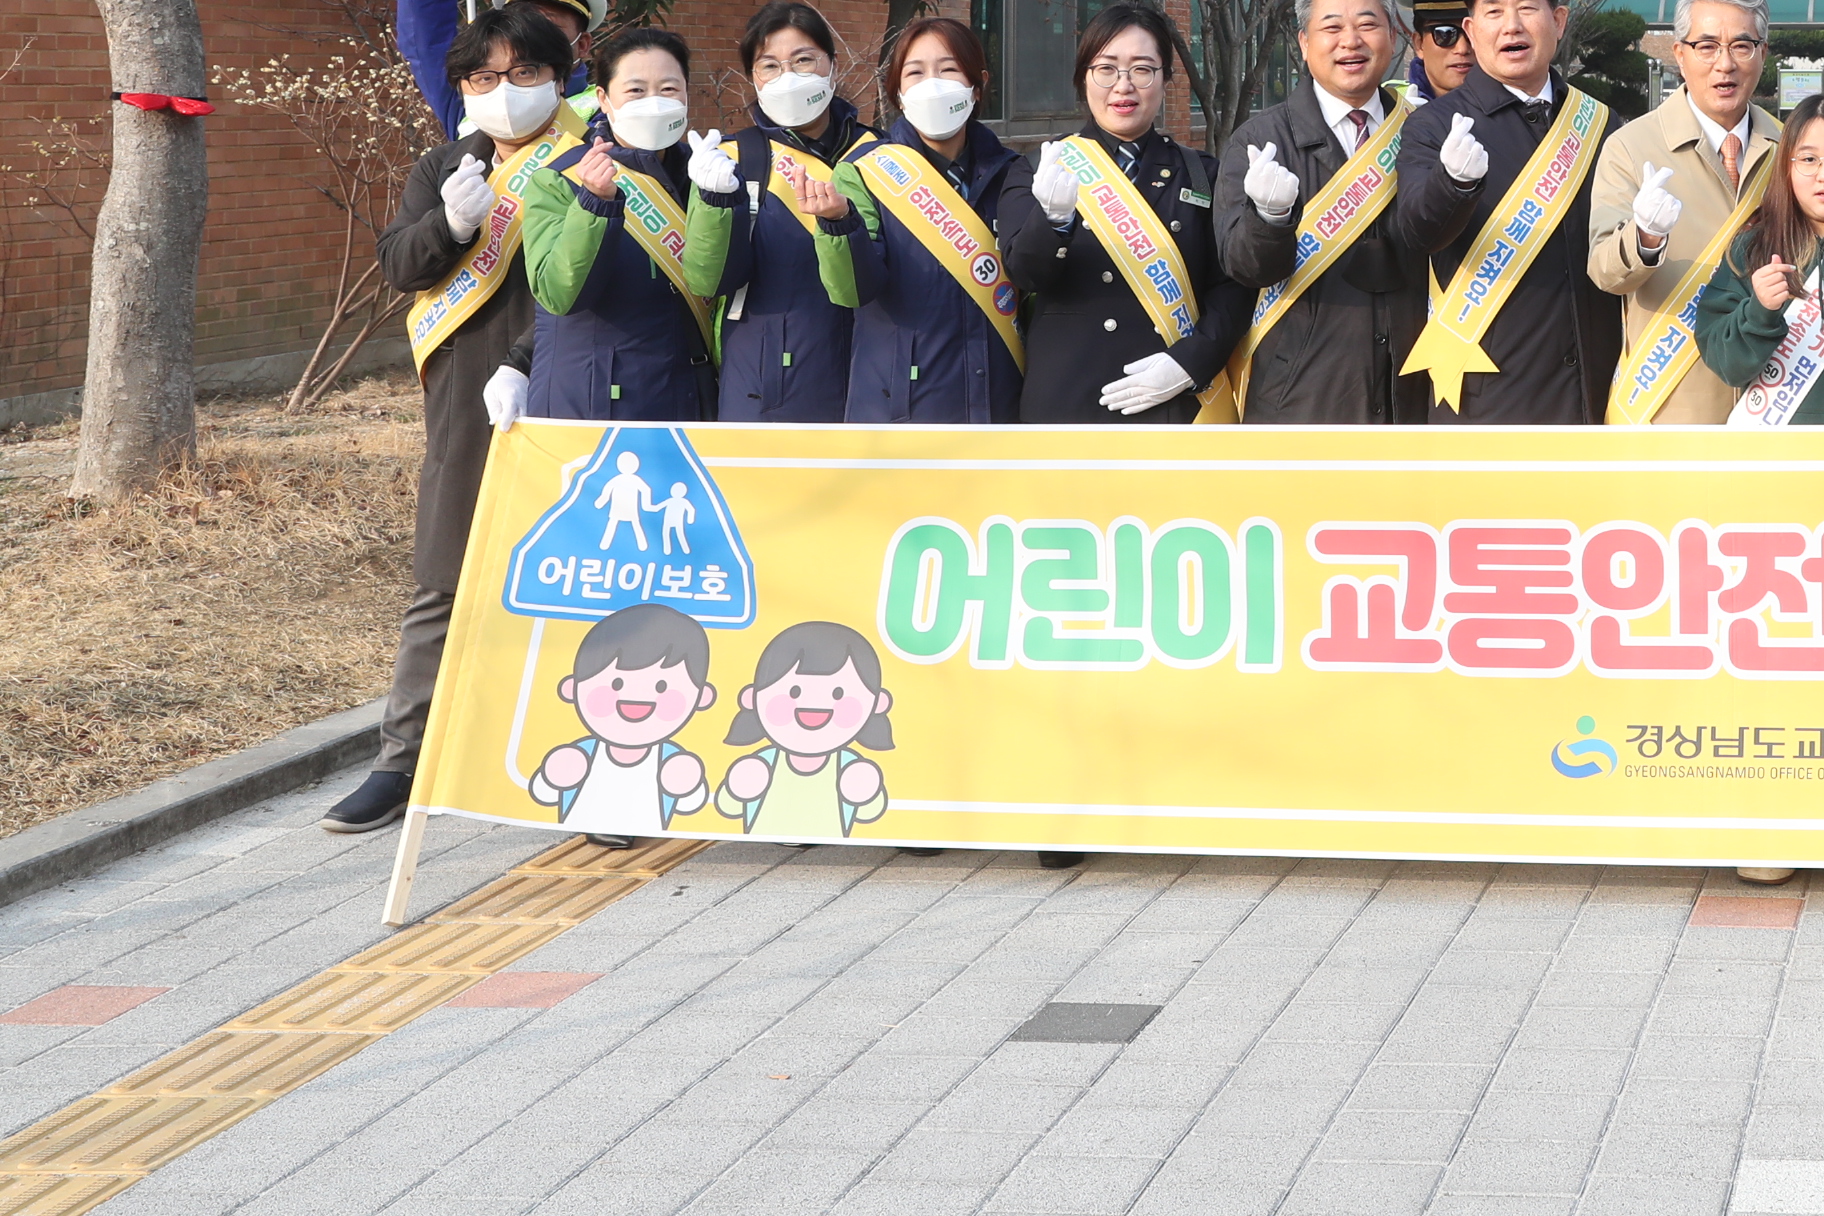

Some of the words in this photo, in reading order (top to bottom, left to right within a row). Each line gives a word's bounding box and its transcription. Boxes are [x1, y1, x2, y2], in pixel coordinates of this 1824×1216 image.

[1314, 164, 1384, 240] 교통안전
[1534, 130, 1582, 203] 교통안전
[908, 185, 980, 260] 안전속도
[974, 259, 996, 282] 30
[1090, 183, 1158, 263] 교통안전
[1143, 258, 1183, 307] 함께
[1503, 198, 1545, 246] 함께
[445, 268, 480, 308] 함께
[1457, 239, 1518, 324] 지켜요!
[1627, 325, 1689, 406] 지켜요!
[1749, 390, 1762, 406] 30
[1763, 363, 1779, 379] 50
[536, 554, 733, 604] 어린이보호
[880, 516, 1282, 673] 어린이
[1624, 764, 1766, 780] GYEONGSANGNAMDO
[1769, 766, 1813, 780] OFFICE
